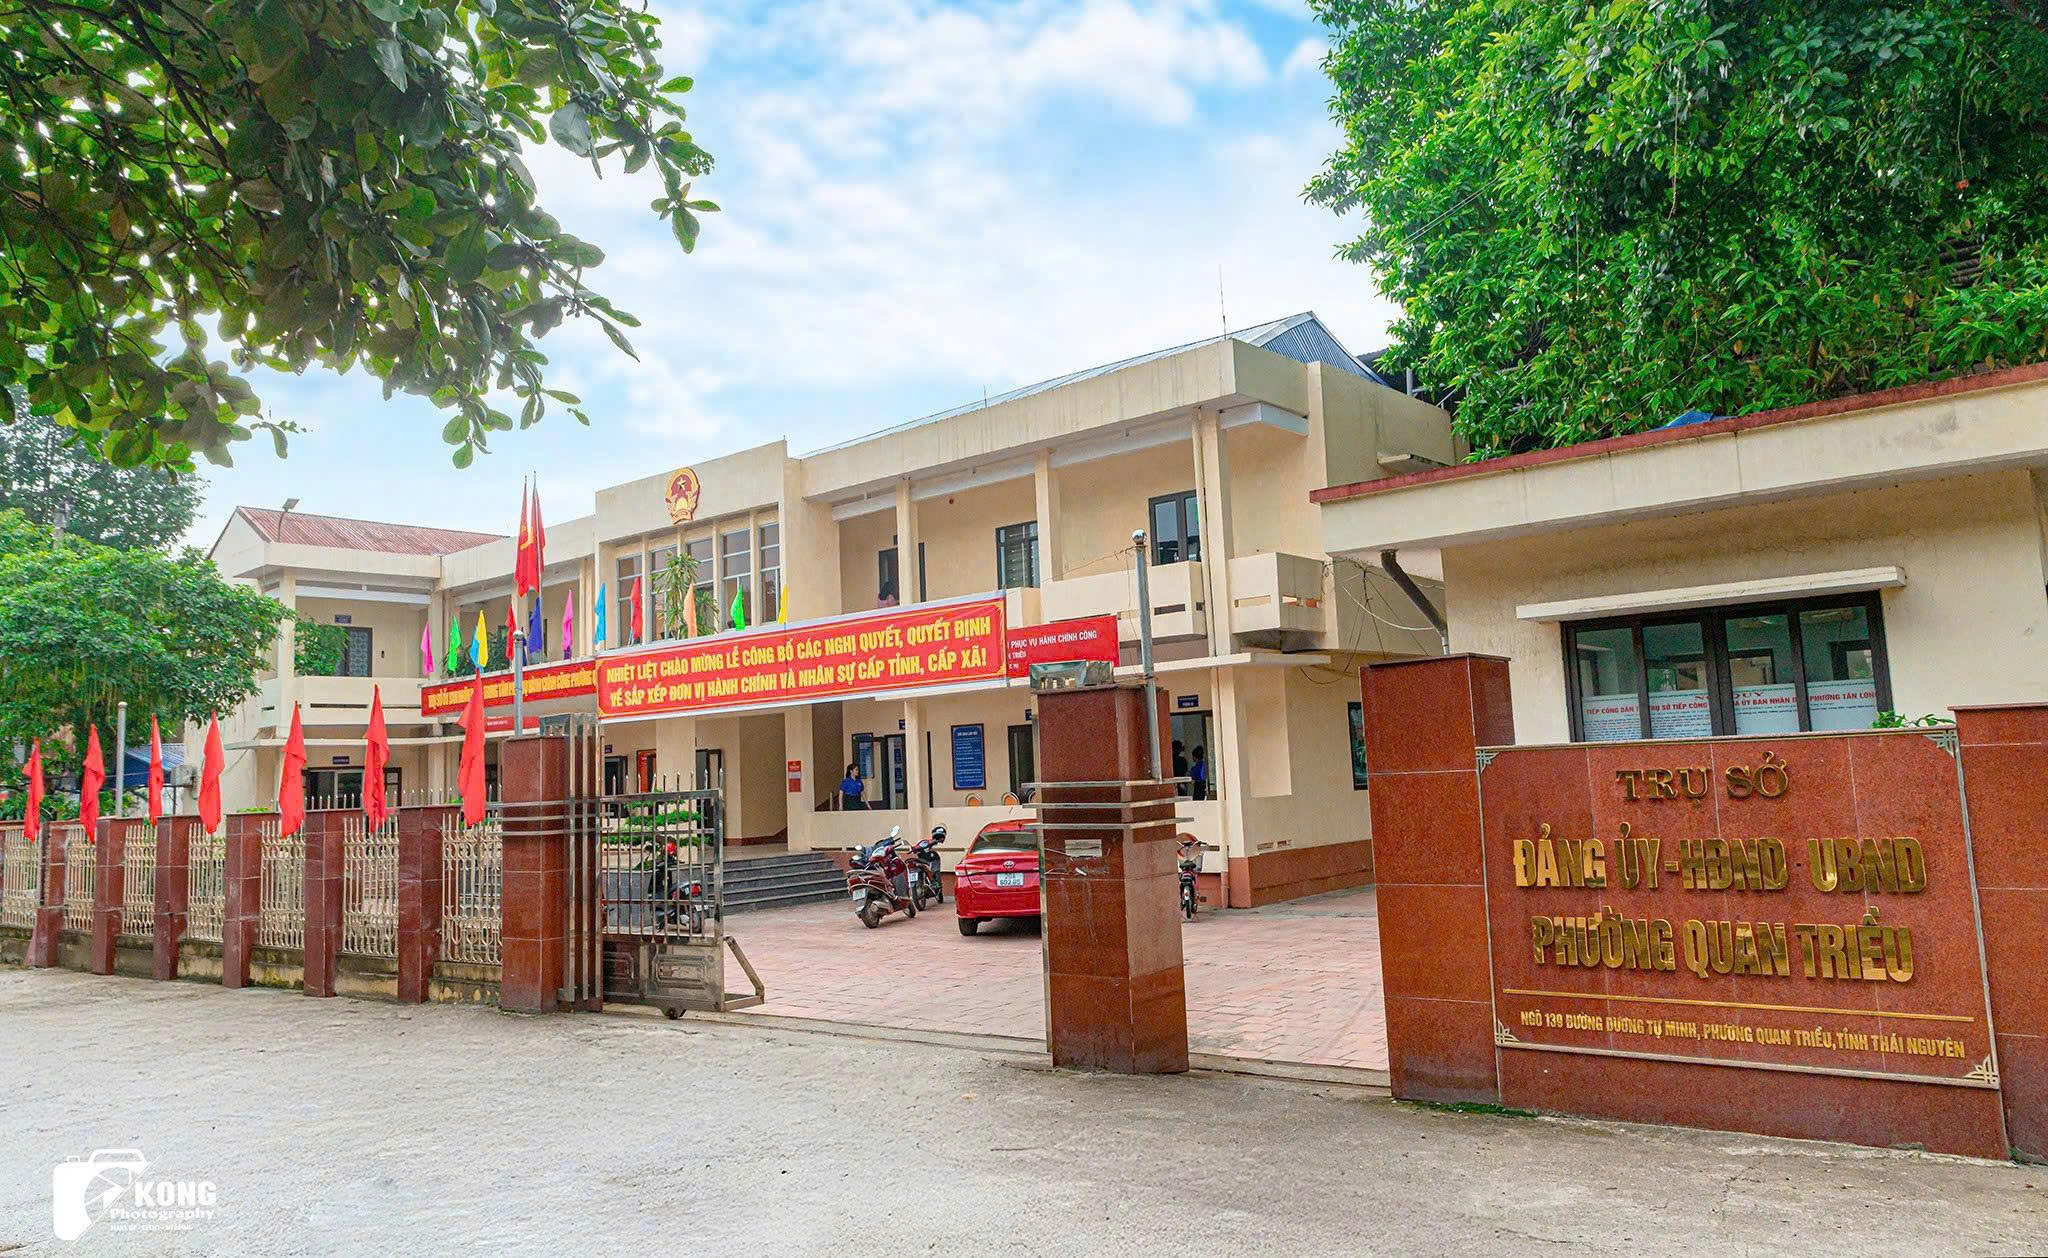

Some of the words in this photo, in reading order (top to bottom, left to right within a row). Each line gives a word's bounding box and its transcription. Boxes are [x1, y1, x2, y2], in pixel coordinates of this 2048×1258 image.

[607, 665, 635, 684] NHIỆT
[637, 660, 657, 681] LIỆT
[660, 657, 689, 677] CHÀO
[691, 652, 724, 673] MỪNG
[726, 645, 739, 668] LỄ
[742, 644, 775, 666] CÔNG
[777, 639, 794, 662] BỐ
[797, 637, 822, 660] CÁC
[825, 634, 857, 656] NGHỊ
[860, 624, 903, 653] QUYẾT,
[907, 617, 951, 644] QUYẾT
[954, 616, 991, 642] ĐỊNH
[1039, 634, 1056, 645] HÀNH
[1079, 629, 1097, 641] CÔNG
[610, 686, 623, 708] VỀ
[624, 685, 645, 707] SẮP
[647, 683, 667, 704] XẾP
[669, 682, 692, 702] ĐƠN
[694, 681, 705, 702] VỊ
[707, 676, 739, 698] HÀNH
[741, 671, 777, 693] CHÍNH
[780, 668, 796, 689] VÀ
[799, 665, 835, 687] NHÂN
[837, 661, 856, 685] SỰ
[858, 655, 885, 680] CẤP
[888, 652, 924, 677] TỈNH,
[927, 647, 957, 672] CẤP
[961, 644, 987, 669] XÃ!
[1616, 766, 1710, 807] TRỤ
[1725, 751, 1789, 799] SỞ
[1513, 823, 1607, 889] ĐẢNG
[1807, 837, 1927, 893] UBND
[1531, 905, 1677, 971] PHƯỜNG
[1682, 920, 1790, 978] QUAN
[1795, 905, 1914, 983] TRIỀU
[1520, 1009, 1543, 1027] NGÕ
[1544, 1013, 1563, 1028] 139
[1647, 1018, 1662, 1039] TỰ
[1756, 1027, 1791, 1046] QUAN
[1871, 1032, 1904, 1054] THÁI
[1906, 1037, 1965, 1058] NGUYÊN
